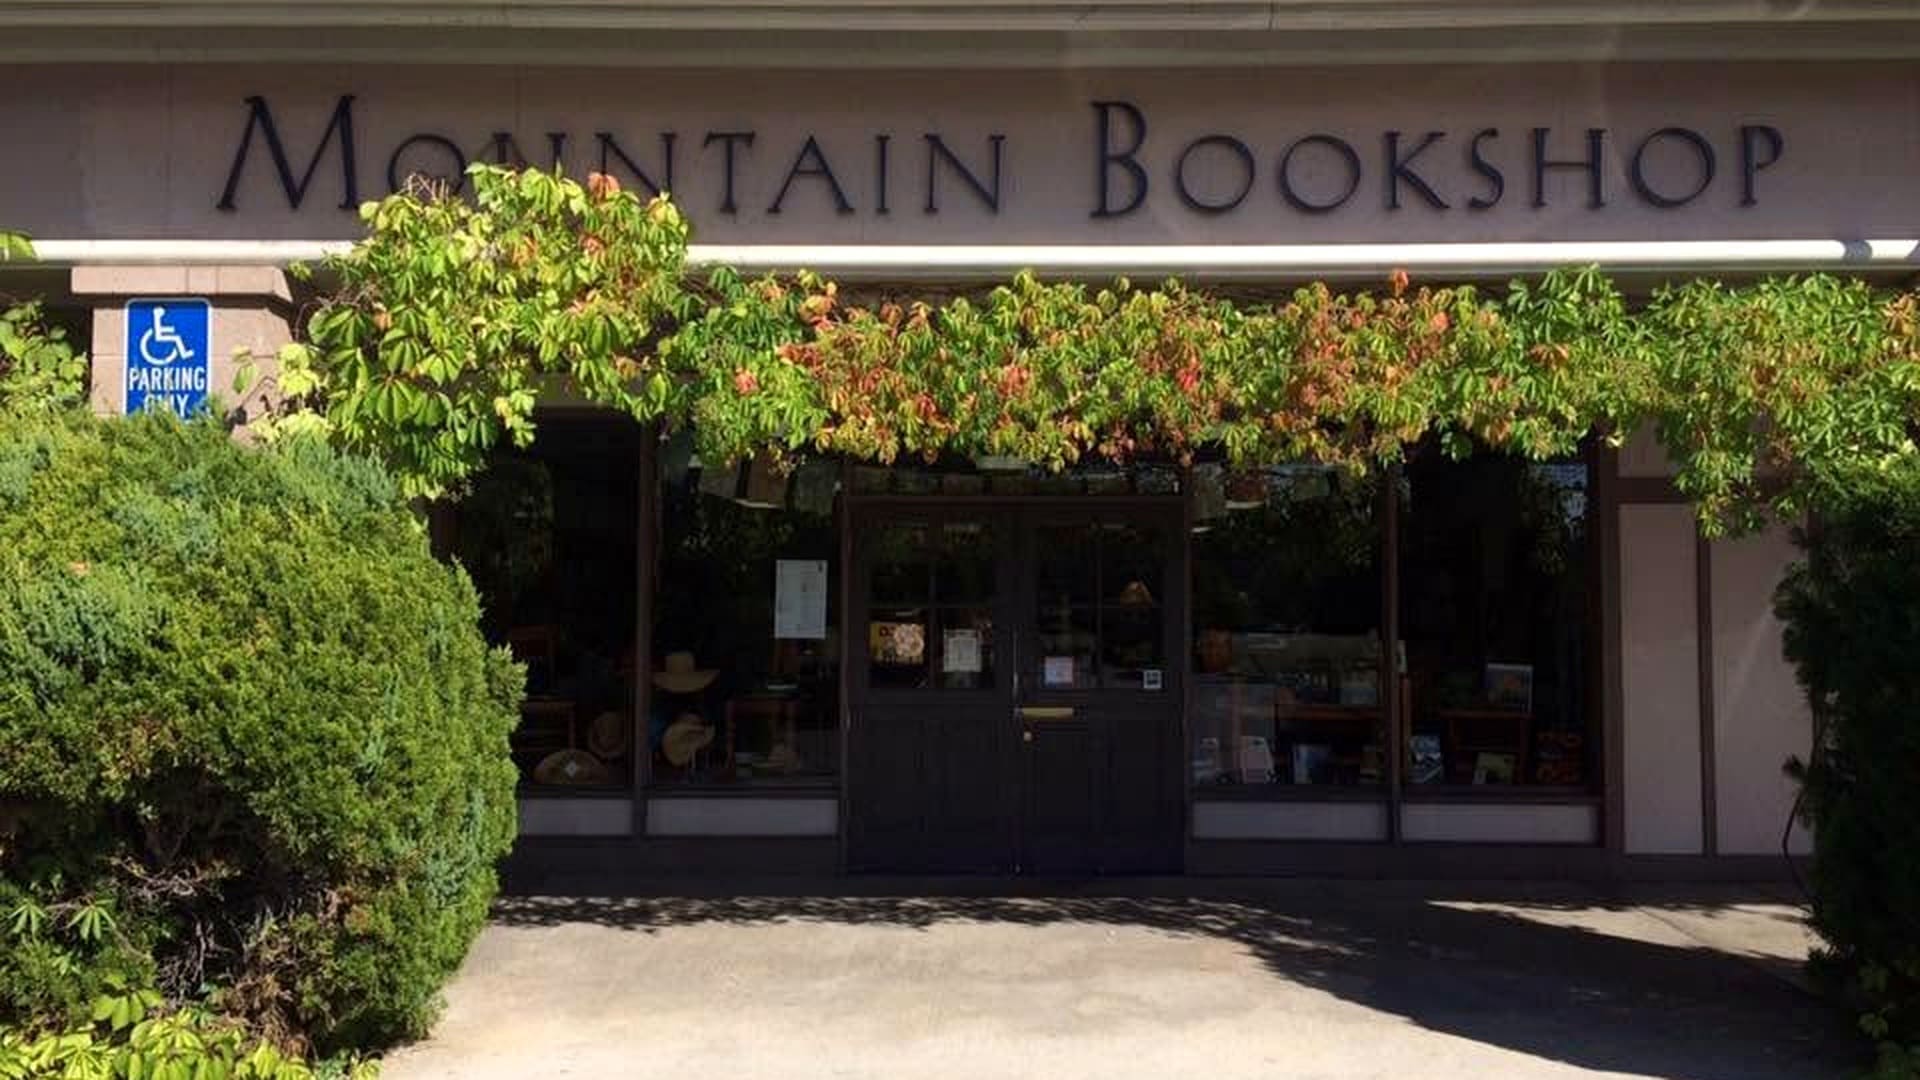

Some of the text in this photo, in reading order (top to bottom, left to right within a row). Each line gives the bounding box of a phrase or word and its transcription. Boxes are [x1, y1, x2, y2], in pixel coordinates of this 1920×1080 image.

[1089, 101, 1786, 220] BOOKSHOP
[128, 366, 206, 392] PARKING
[144, 394, 190, 418] OY
